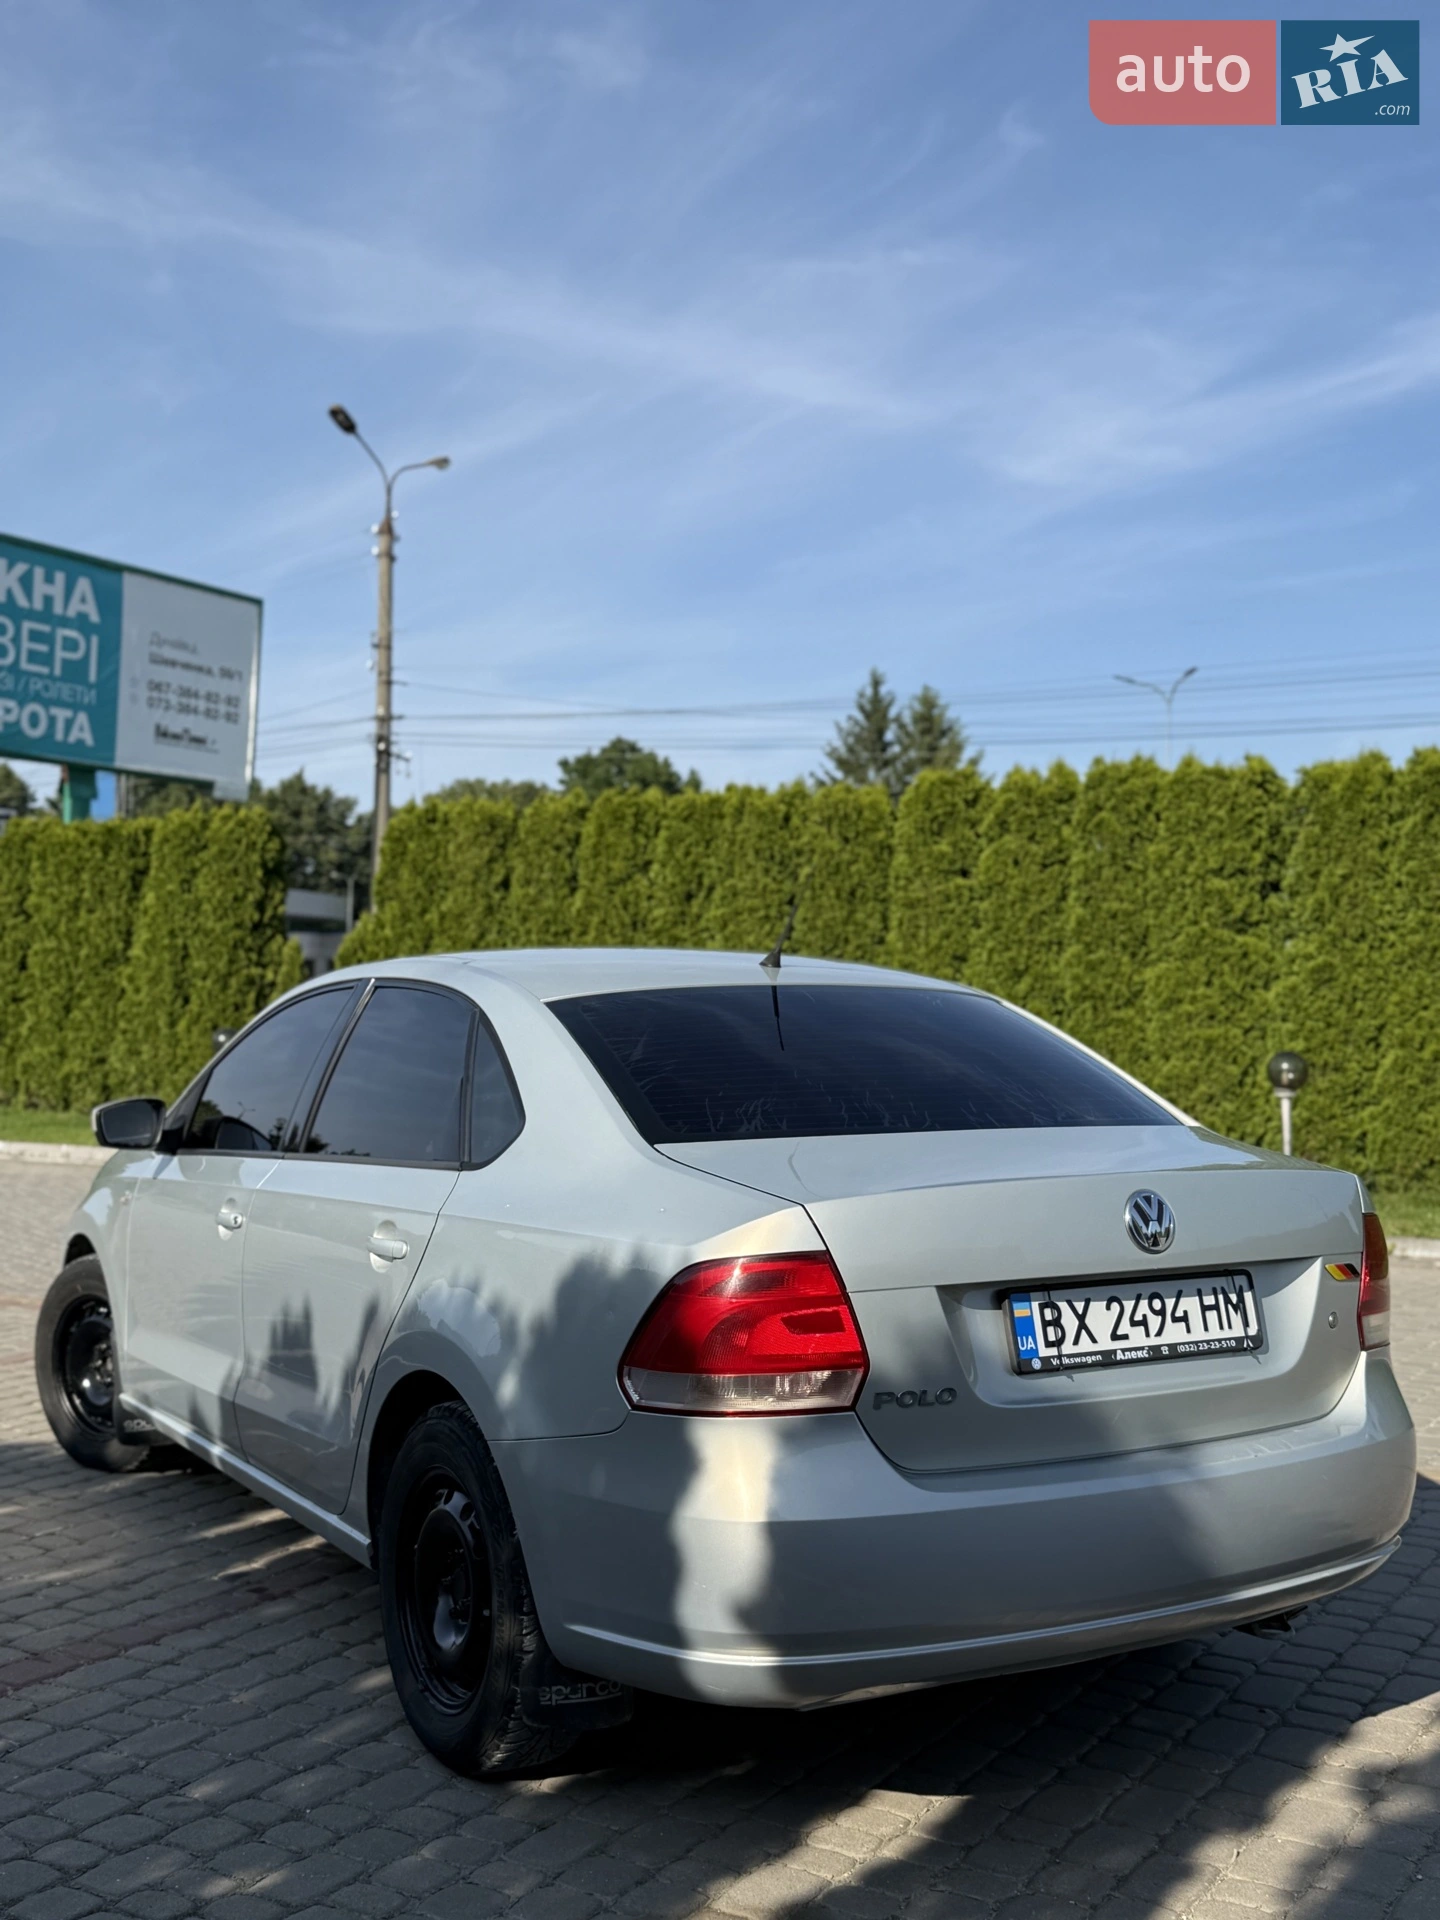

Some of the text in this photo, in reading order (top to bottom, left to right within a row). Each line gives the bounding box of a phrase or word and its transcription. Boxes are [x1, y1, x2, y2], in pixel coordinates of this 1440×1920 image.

[1038, 1297, 1098, 1348] BX
[1105, 1289, 1191, 1342] 2494
[1017, 1335, 1036, 1351] UA
[1177, 1339, 1236, 1354] (032) 23-23-510
[872, 1387, 958, 1411] POLO
